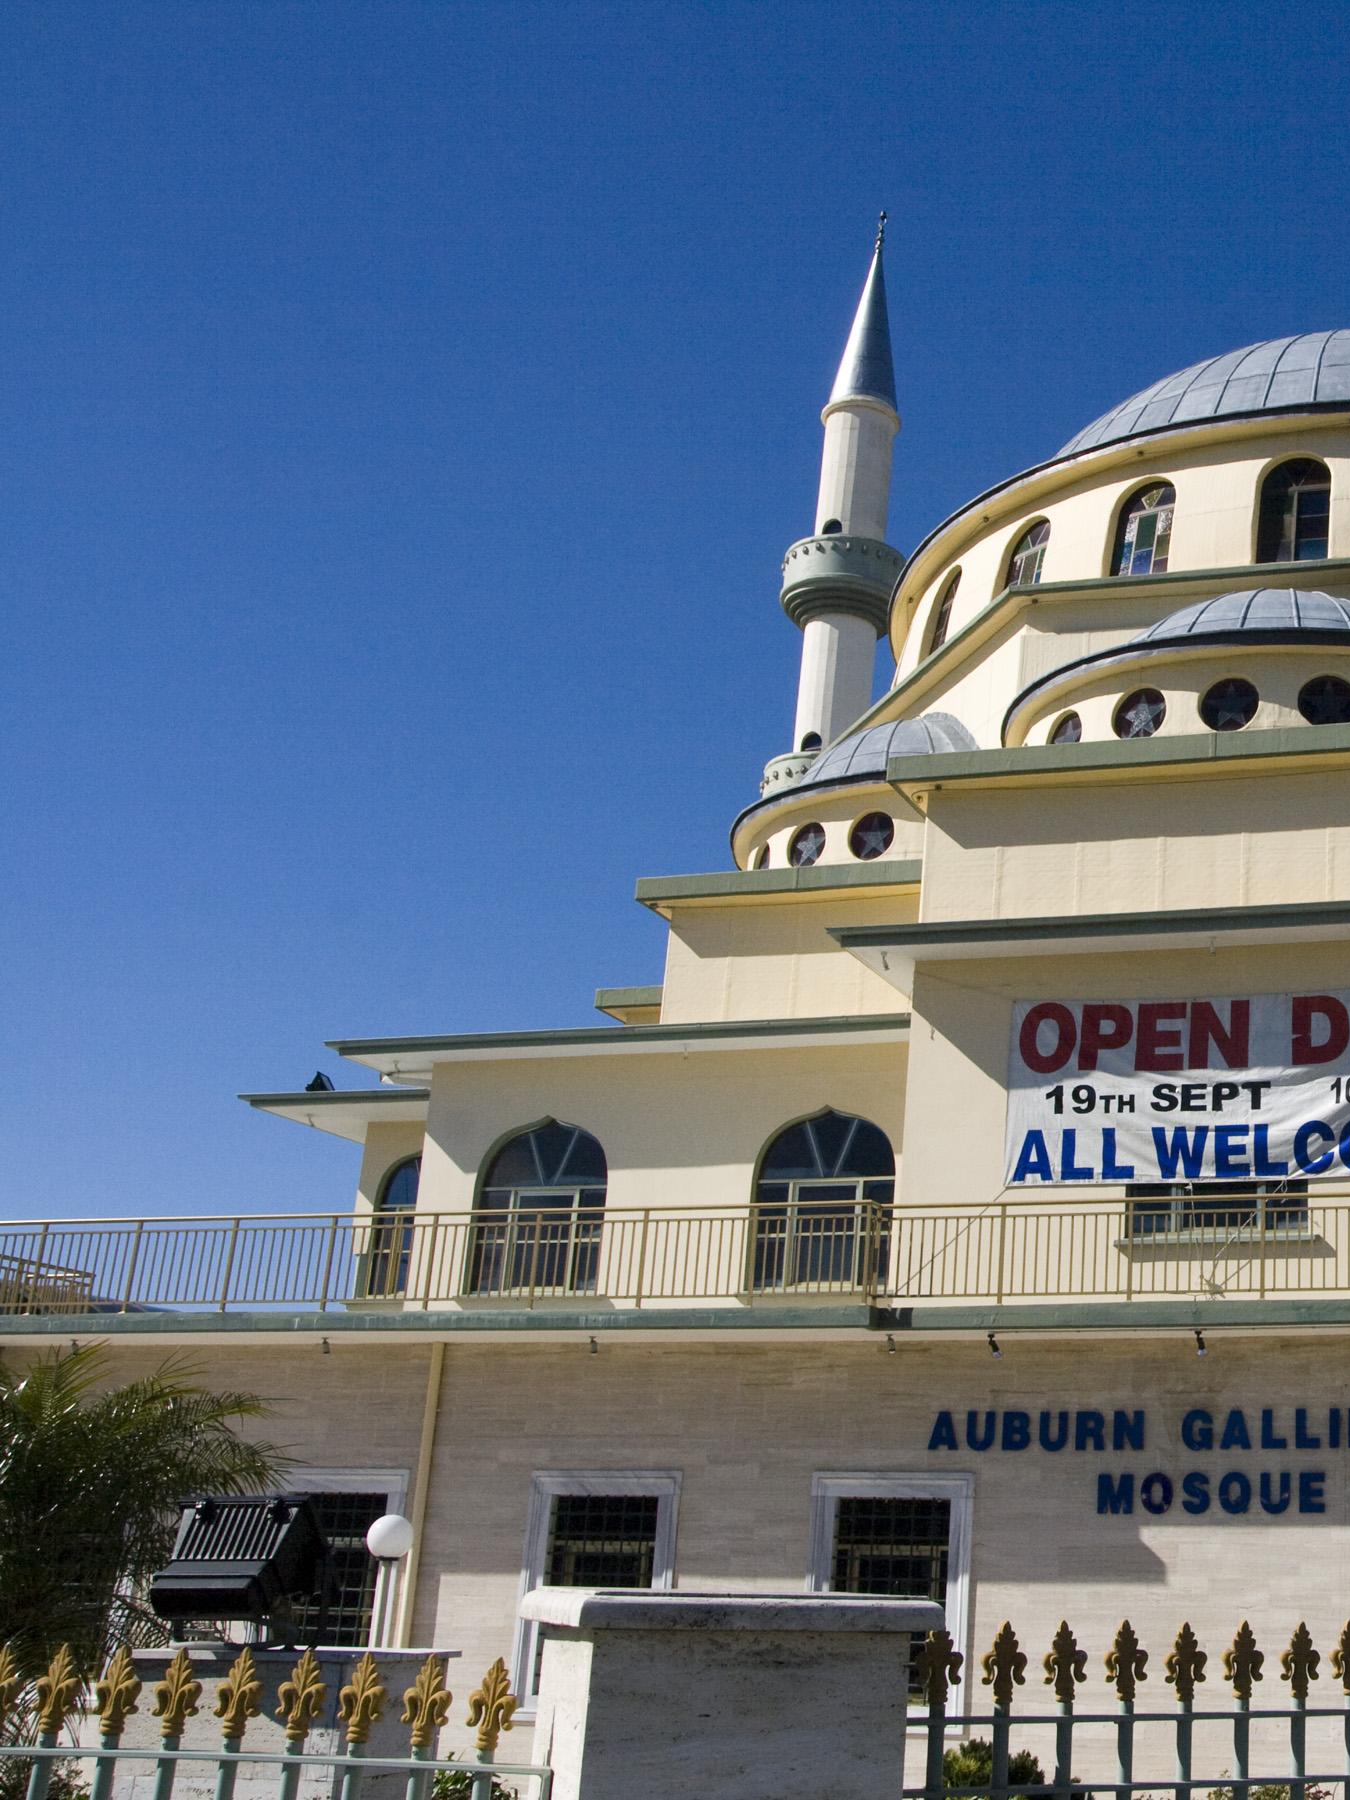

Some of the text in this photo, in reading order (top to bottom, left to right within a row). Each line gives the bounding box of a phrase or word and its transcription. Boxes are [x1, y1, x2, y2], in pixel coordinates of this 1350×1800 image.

[1019, 999, 1249, 1074] OPEN
[1045, 1084, 1135, 1114] 19TH
[1150, 1081, 1271, 1112] SEPT
[1013, 1128, 1134, 1182] ALL
[928, 1410, 1145, 1451] AUBURN
[1097, 1471, 1326, 1515] MOSQUE
